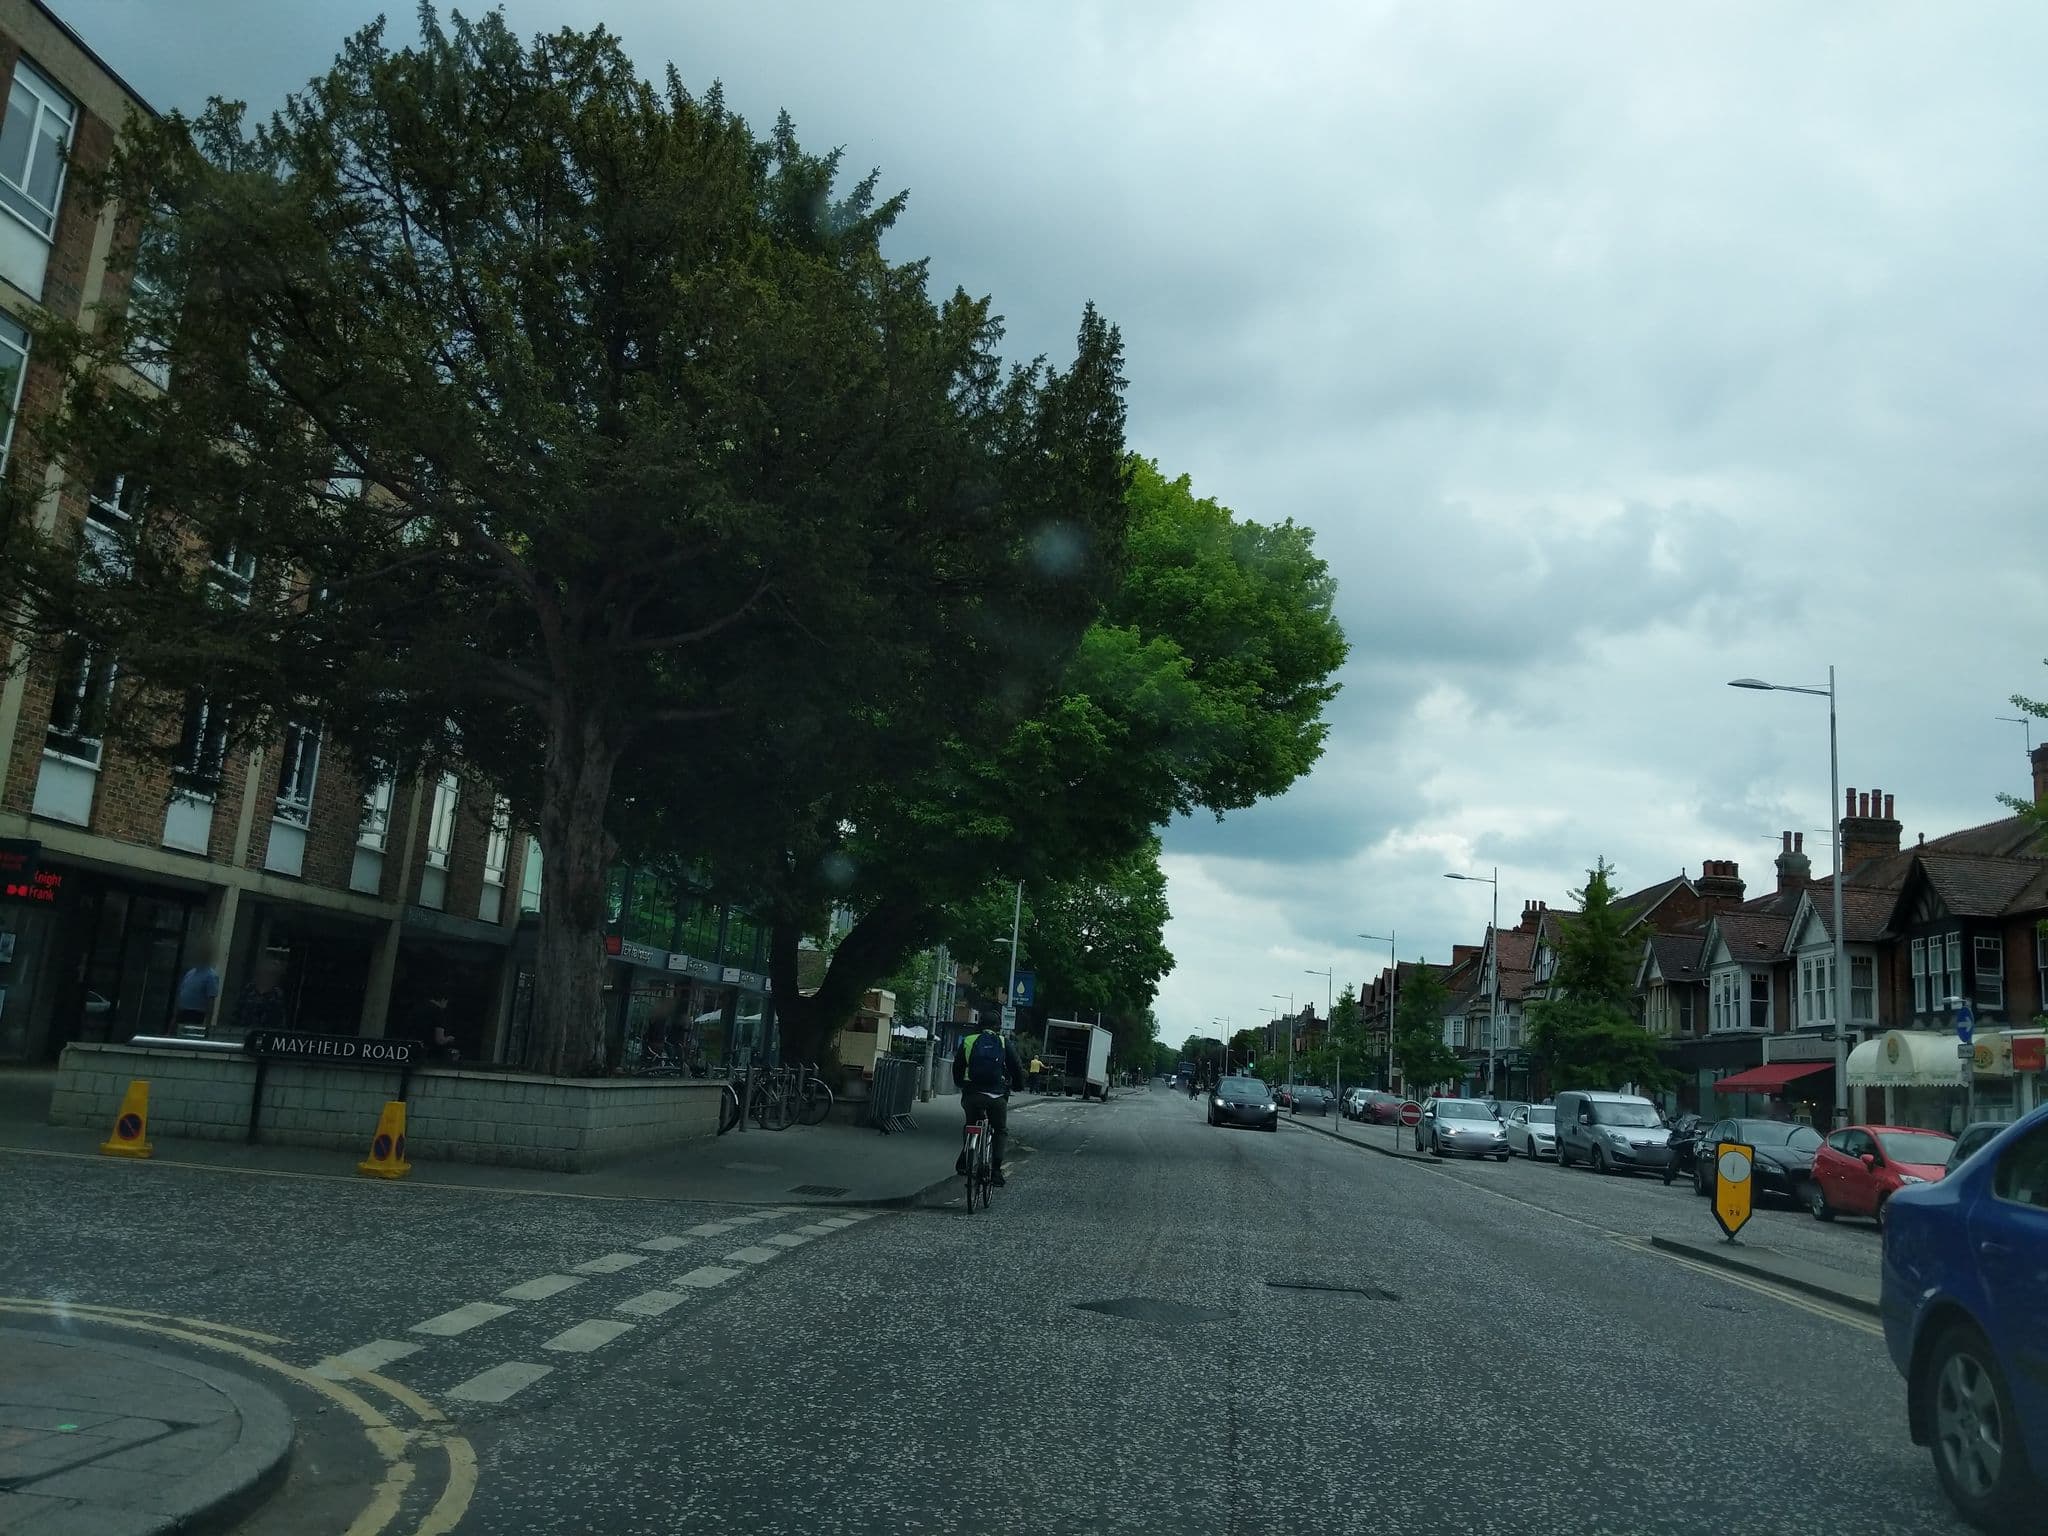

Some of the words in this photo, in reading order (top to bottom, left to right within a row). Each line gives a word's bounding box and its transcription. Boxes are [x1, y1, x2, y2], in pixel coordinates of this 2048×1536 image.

[29, 885, 55, 902] Frank
[271, 1036, 356, 1057] MAYFIELD
[361, 1043, 409, 1061] ROAD
